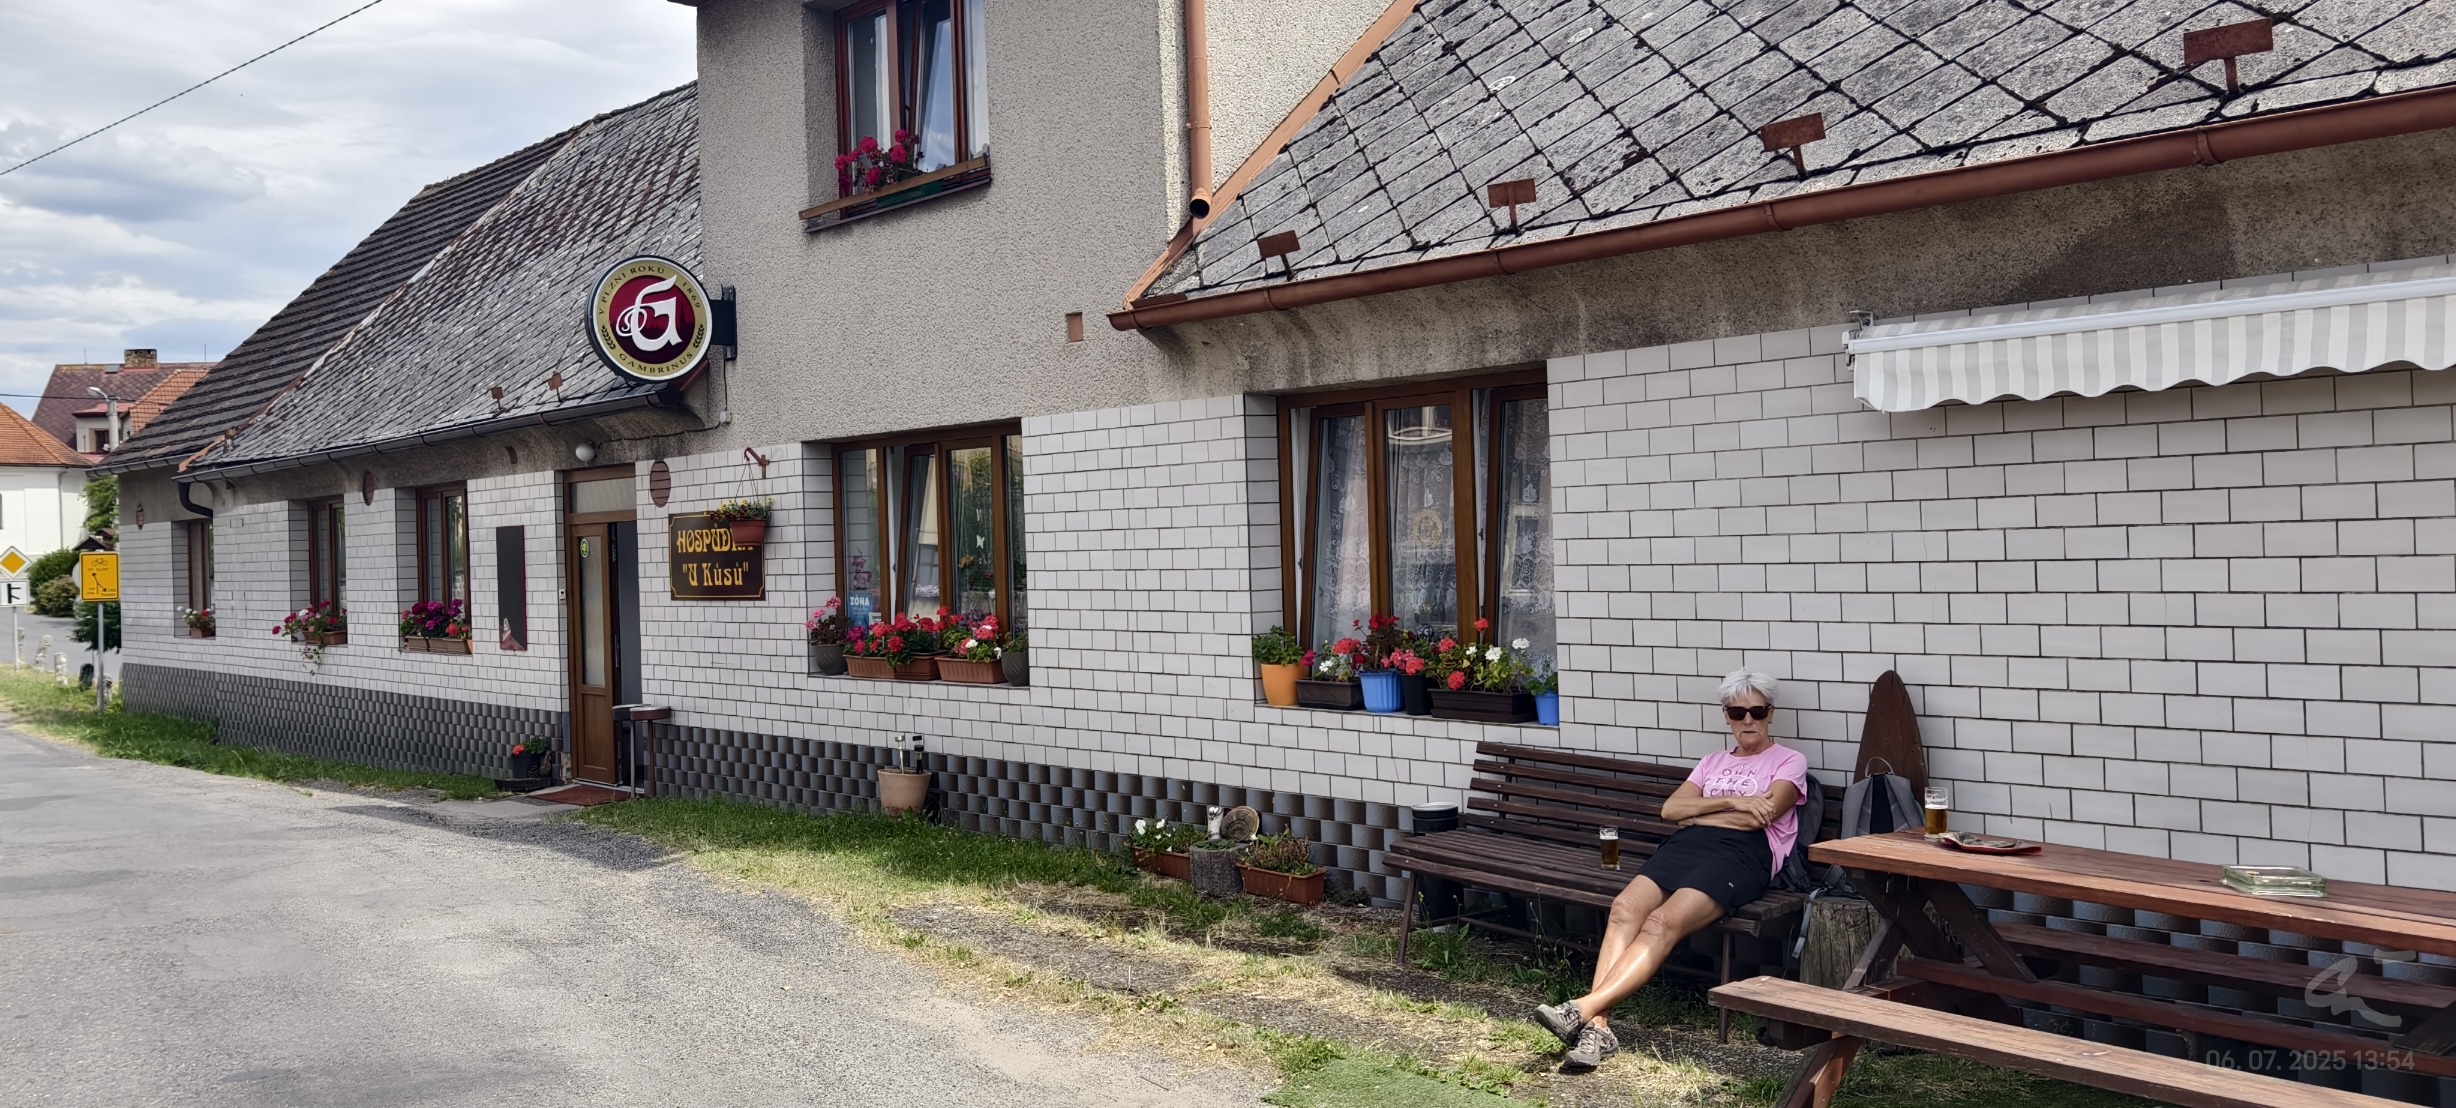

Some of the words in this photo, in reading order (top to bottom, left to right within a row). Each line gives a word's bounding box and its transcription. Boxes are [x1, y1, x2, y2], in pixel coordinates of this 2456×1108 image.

[630, 265, 665, 275] ROKU
[682, 282, 701, 308] 1869
[619, 352, 693, 374] GAMBRINUS
[1715, 777, 1751, 786] THE
